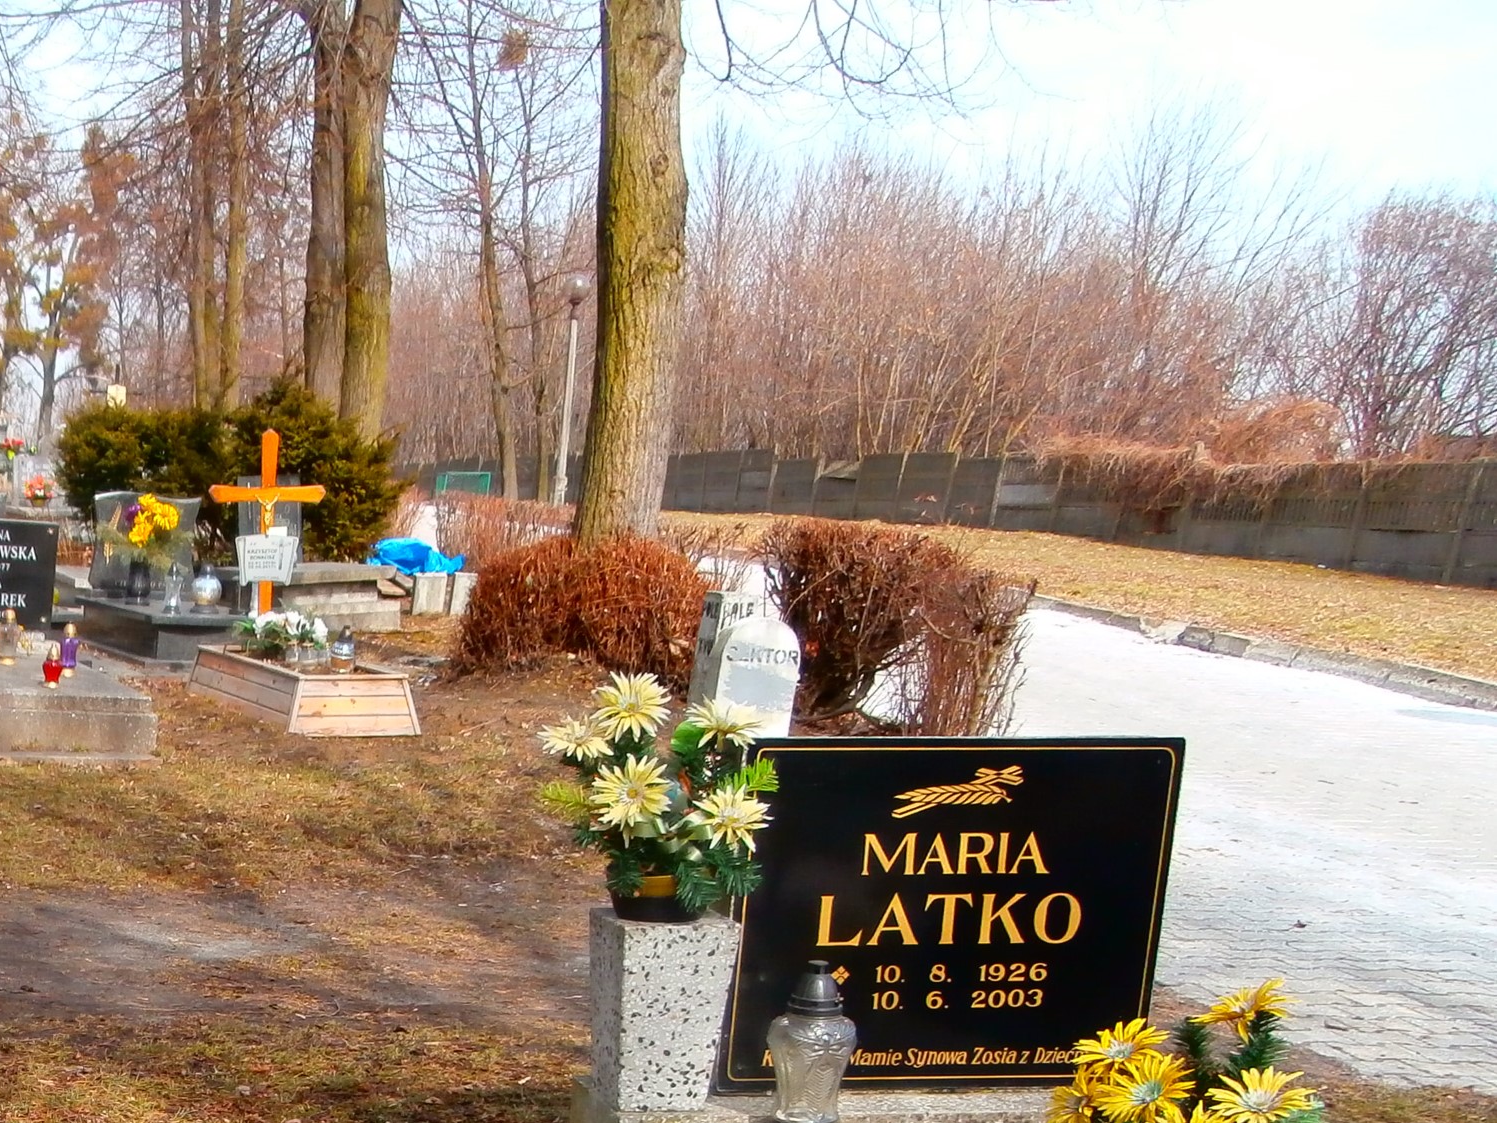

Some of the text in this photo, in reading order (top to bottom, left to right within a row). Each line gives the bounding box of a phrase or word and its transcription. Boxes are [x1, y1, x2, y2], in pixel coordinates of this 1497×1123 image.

[860, 831, 1050, 876] MARIA
[815, 892, 1082, 947] LATKO
[875, 962, 1048, 983] 10. 8. 1926
[872, 988, 1044, 1011] 10. 6. 2003
[849, 1048, 902, 1066] Mamie
[904, 1047, 967, 1068] Synowa
[971, 1046, 1018, 1065] Zosia
[1018, 1050, 1032, 1065] z
